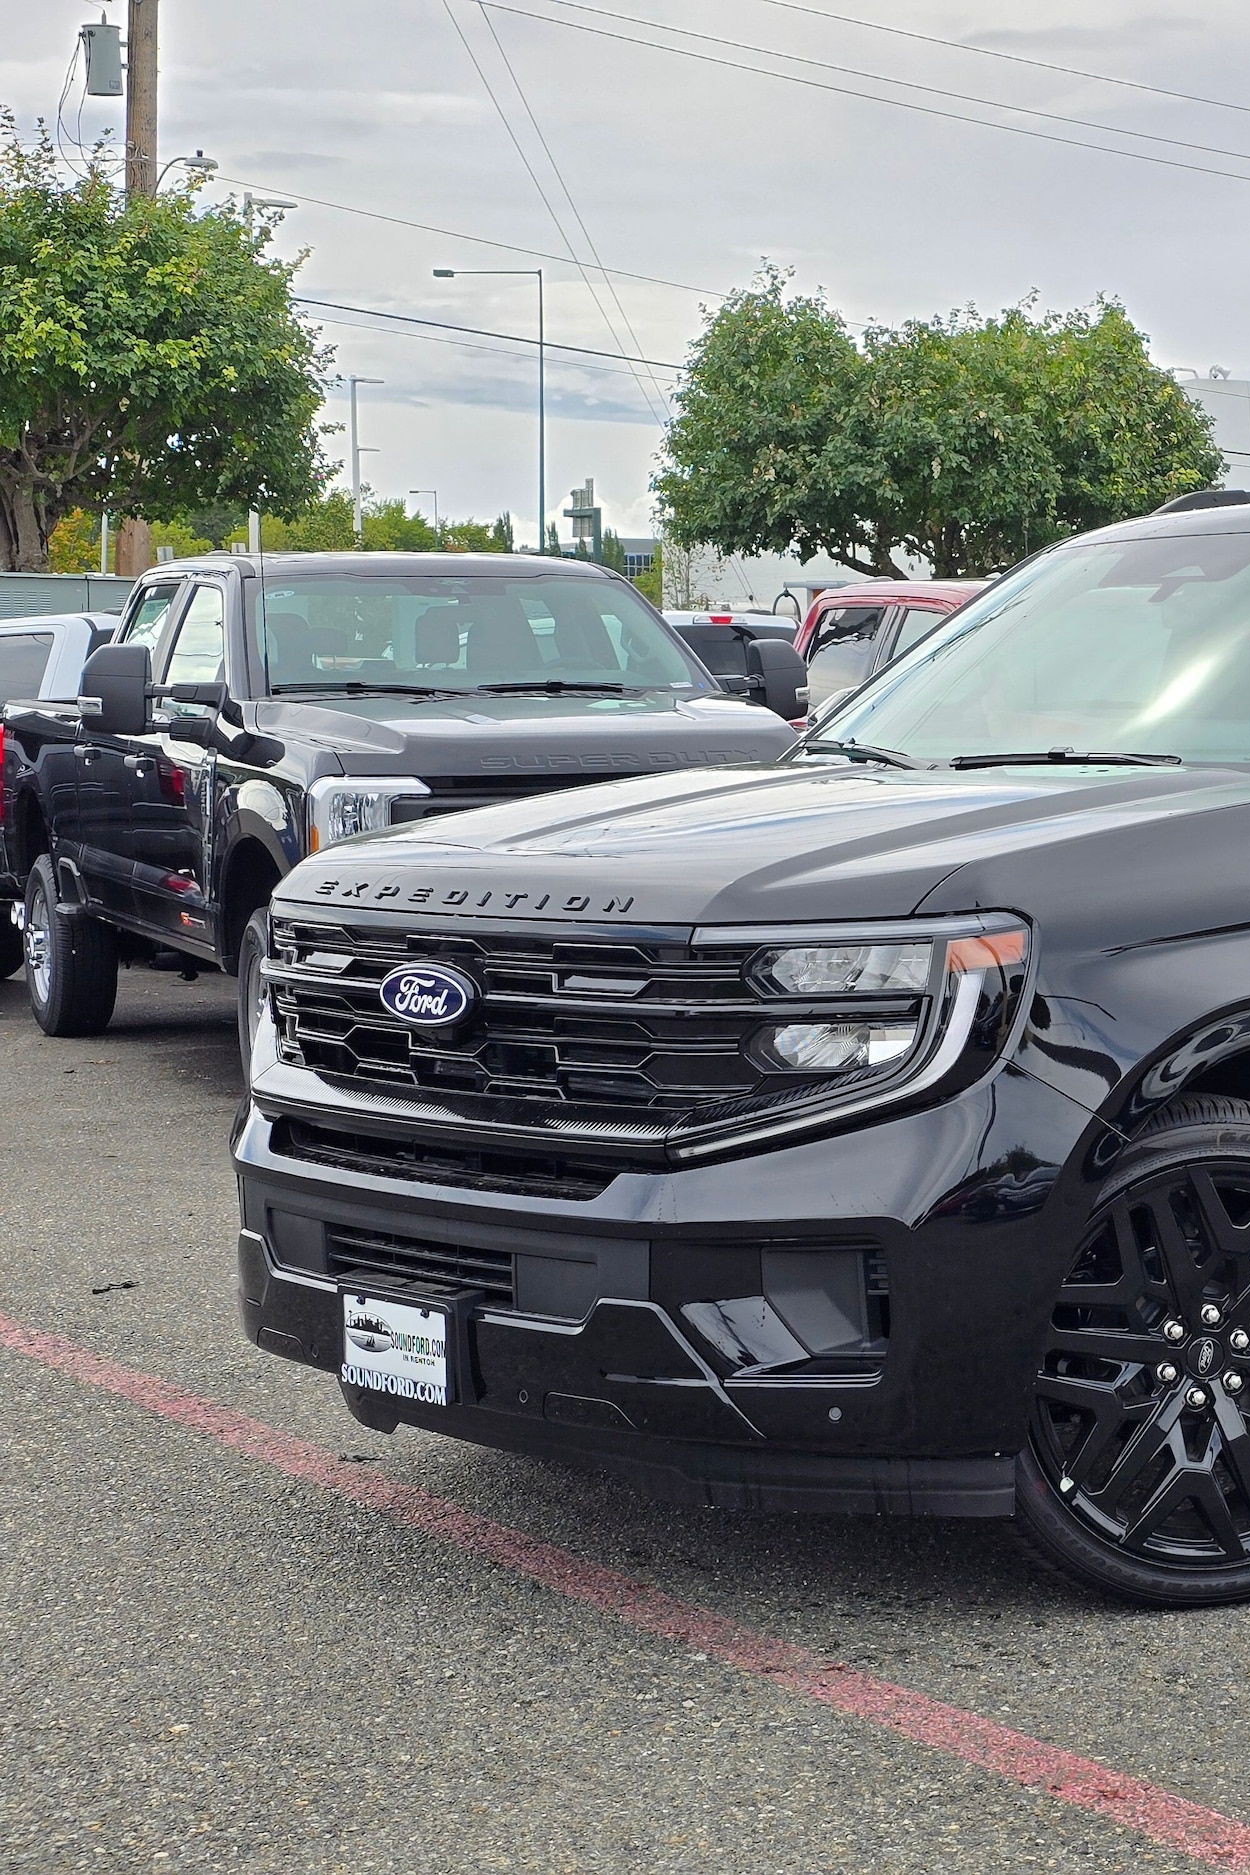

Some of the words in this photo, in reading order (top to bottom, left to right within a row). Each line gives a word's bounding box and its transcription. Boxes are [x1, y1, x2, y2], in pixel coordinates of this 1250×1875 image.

[480, 751, 640, 769] SUPER
[649, 749, 758, 765] DUTY
[315, 880, 635, 912] EXPEDITION
[395, 975, 448, 1016] Ford
[390, 1331, 446, 1358] SOUNDFORD.COM
[341, 1362, 447, 1406] SOUNDFORD.COM
